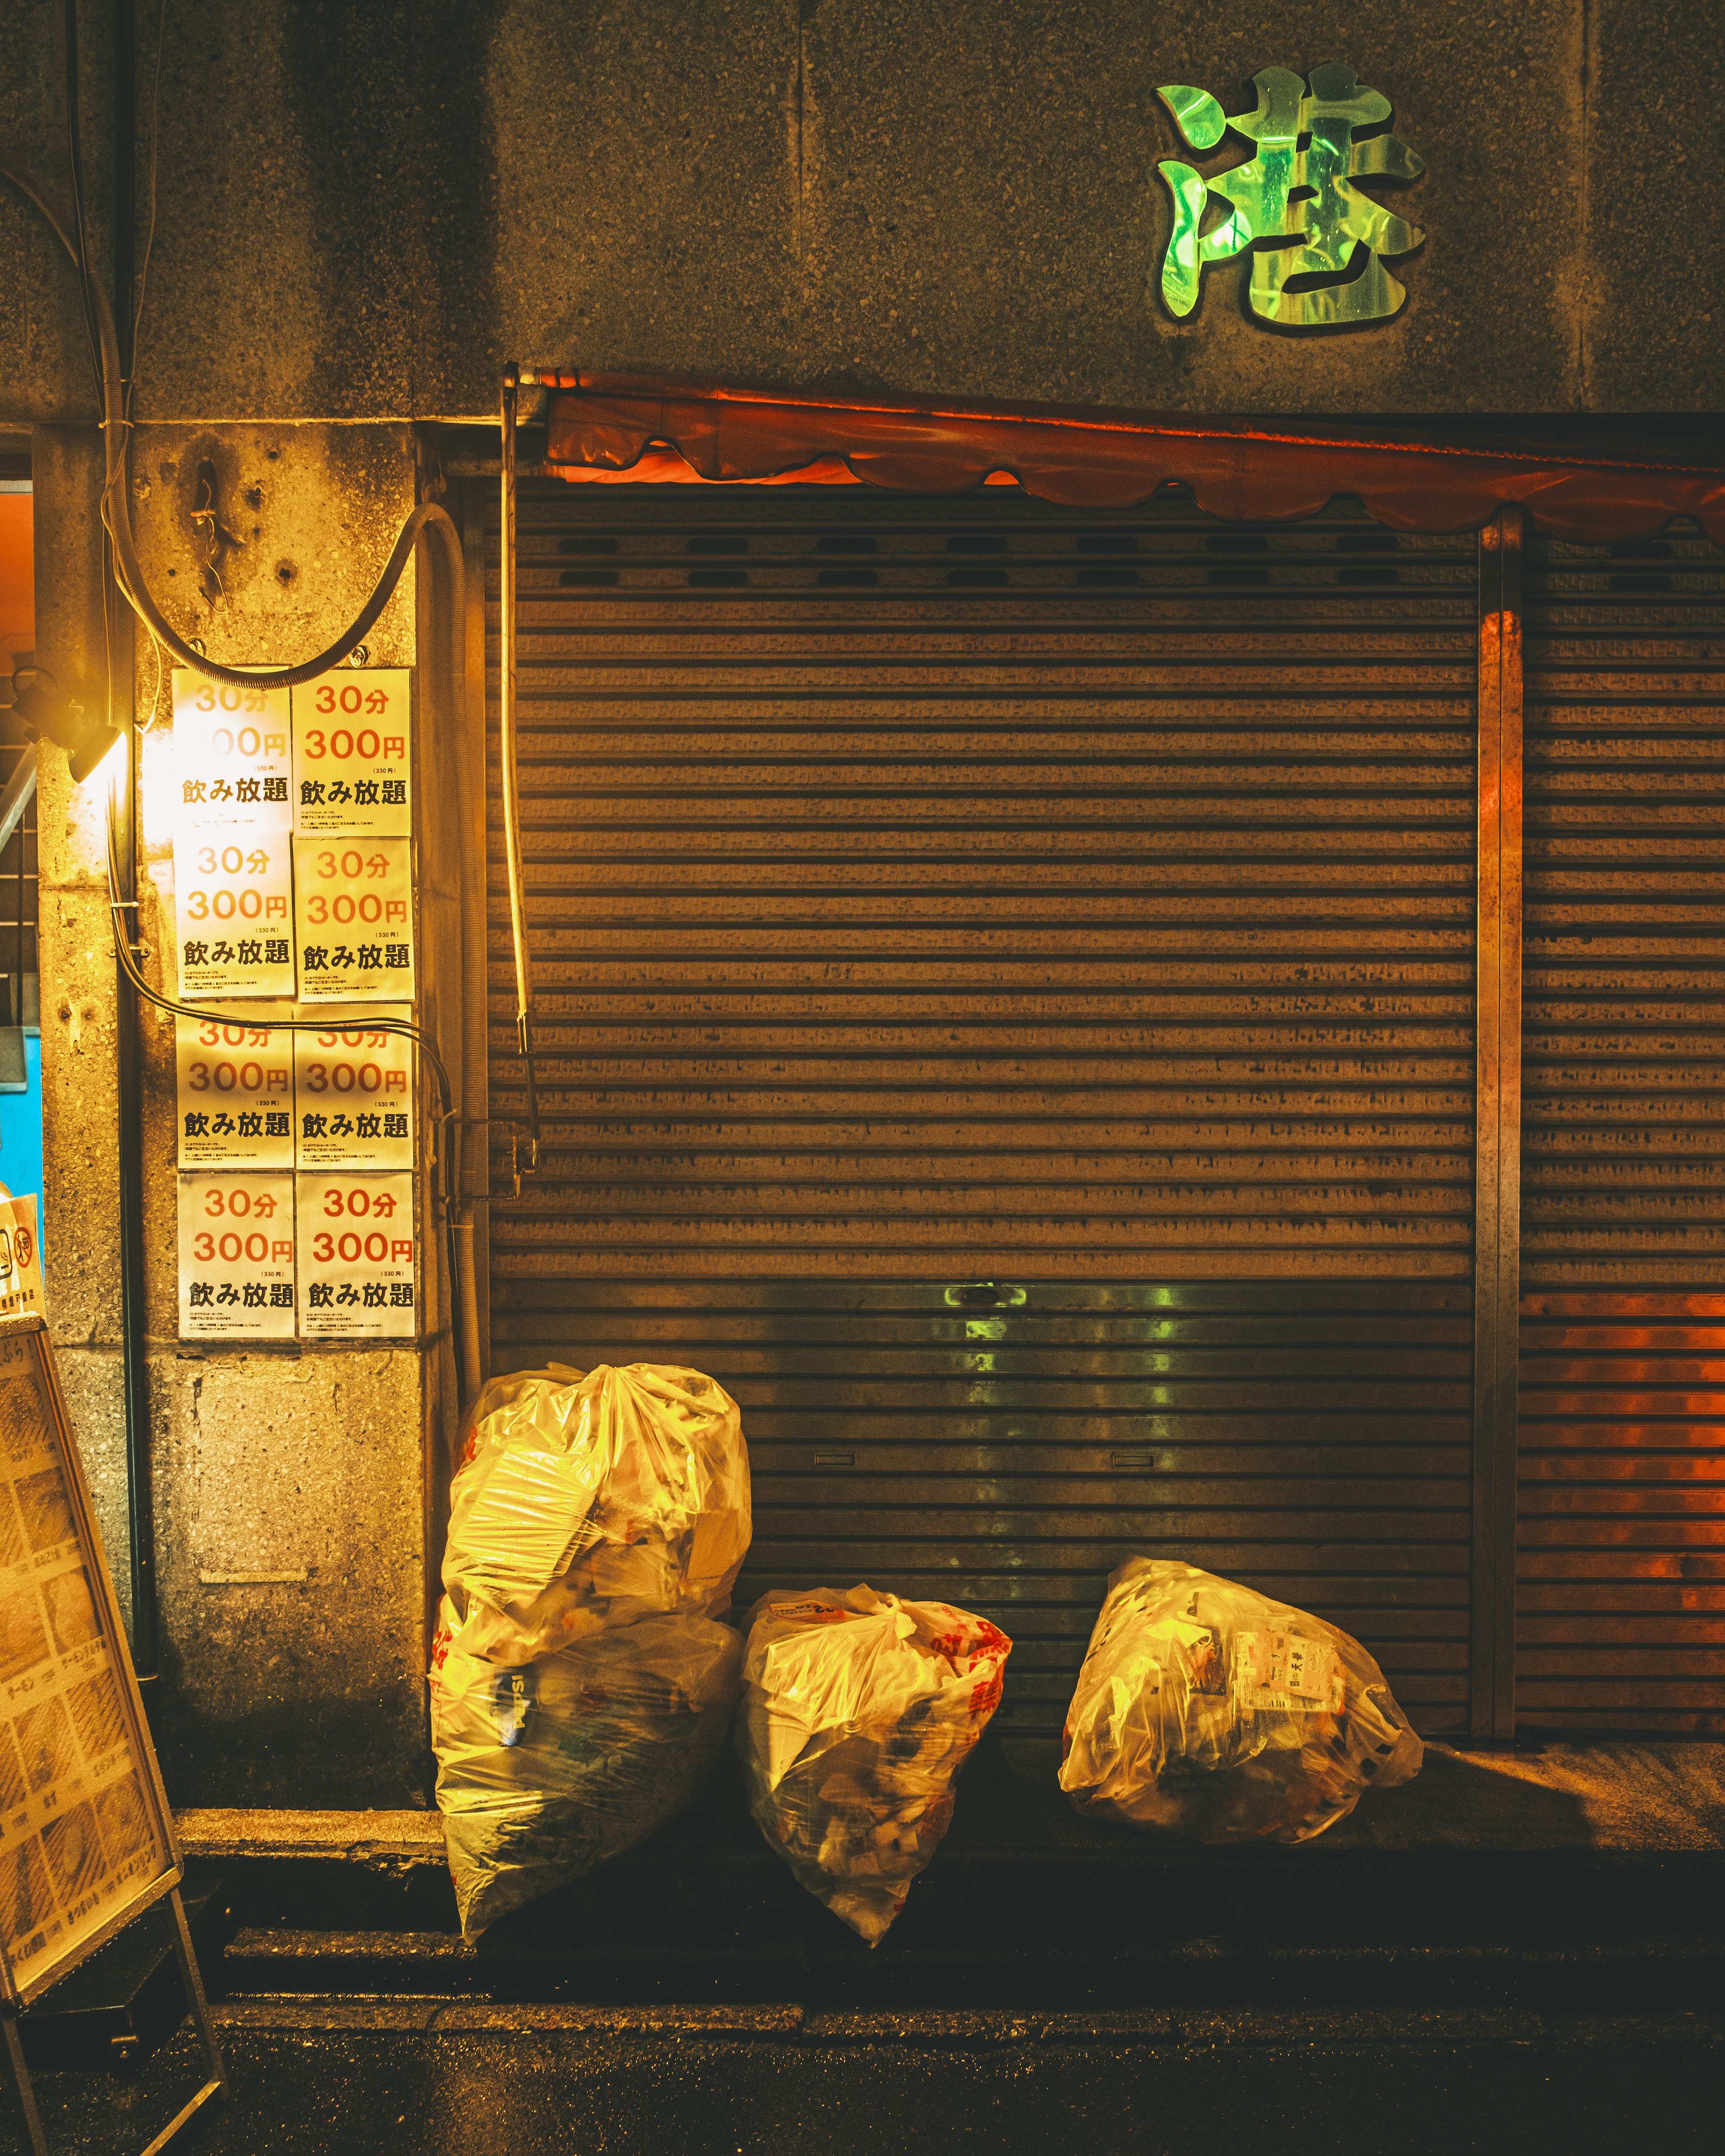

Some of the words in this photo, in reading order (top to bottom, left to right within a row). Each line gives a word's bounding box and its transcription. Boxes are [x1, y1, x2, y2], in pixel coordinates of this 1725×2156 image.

[1156, 61, 1426, 325] 港
[196, 684, 269, 712] 30分
[316, 685, 389, 714] 30分
[212, 726, 287, 757] 00円
[305, 729, 404, 759] 300円
[183, 778, 288, 803] 飲み放題
[301, 780, 407, 805] 飲み放題
[199, 846, 270, 875] 30分
[317, 850, 390, 879] 30分
[188, 889, 287, 920] 300円
[307, 894, 407, 924] 300円
[184, 939, 289, 966] 飲み放題
[304, 944, 410, 971] 飲み放題
[199, 1020, 272, 1047] 30分
[189, 1062, 288, 1092] 300円
[307, 1063, 407, 1093] 300円
[184, 1112, 290, 1137] 飲み放題
[302, 1113, 408, 1139] 飲み放題
[205, 1189, 278, 1218] 30分
[324, 1189, 397, 1218] 30分
[194, 1233, 293, 1263] 300円
[313, 1233, 412, 1263] 300円
[190, 1282, 293, 1308] 飲み放題
[309, 1282, 413, 1308] 飲み放題
[511, 1674, 526, 1729] PEPSI
